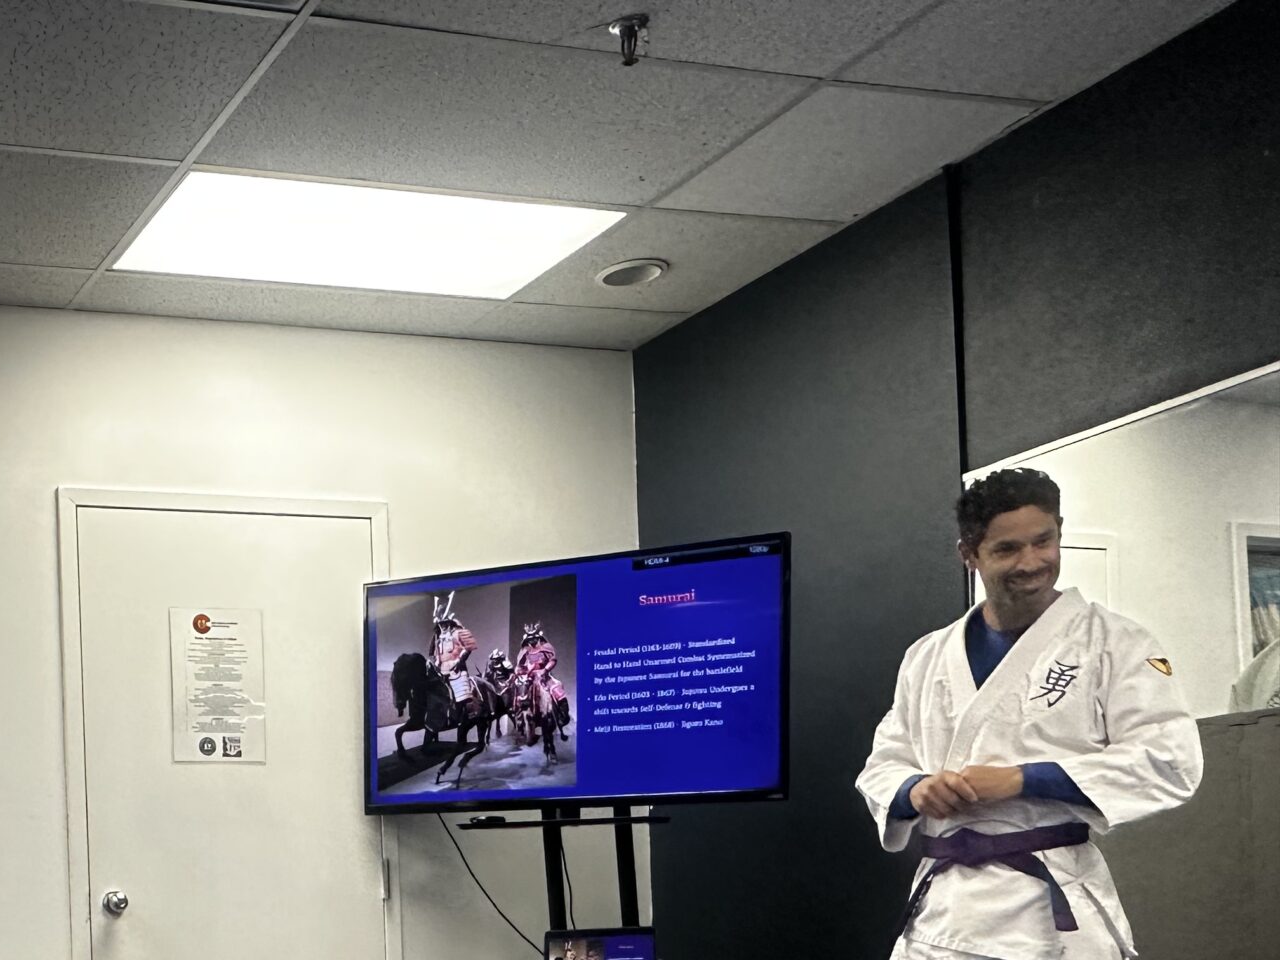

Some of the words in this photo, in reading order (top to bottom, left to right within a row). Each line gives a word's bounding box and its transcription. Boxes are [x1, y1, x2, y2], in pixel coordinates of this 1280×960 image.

[638, 588, 695, 606] Samurai
[680, 670, 692, 678] for
[608, 692, 630, 700] Period
